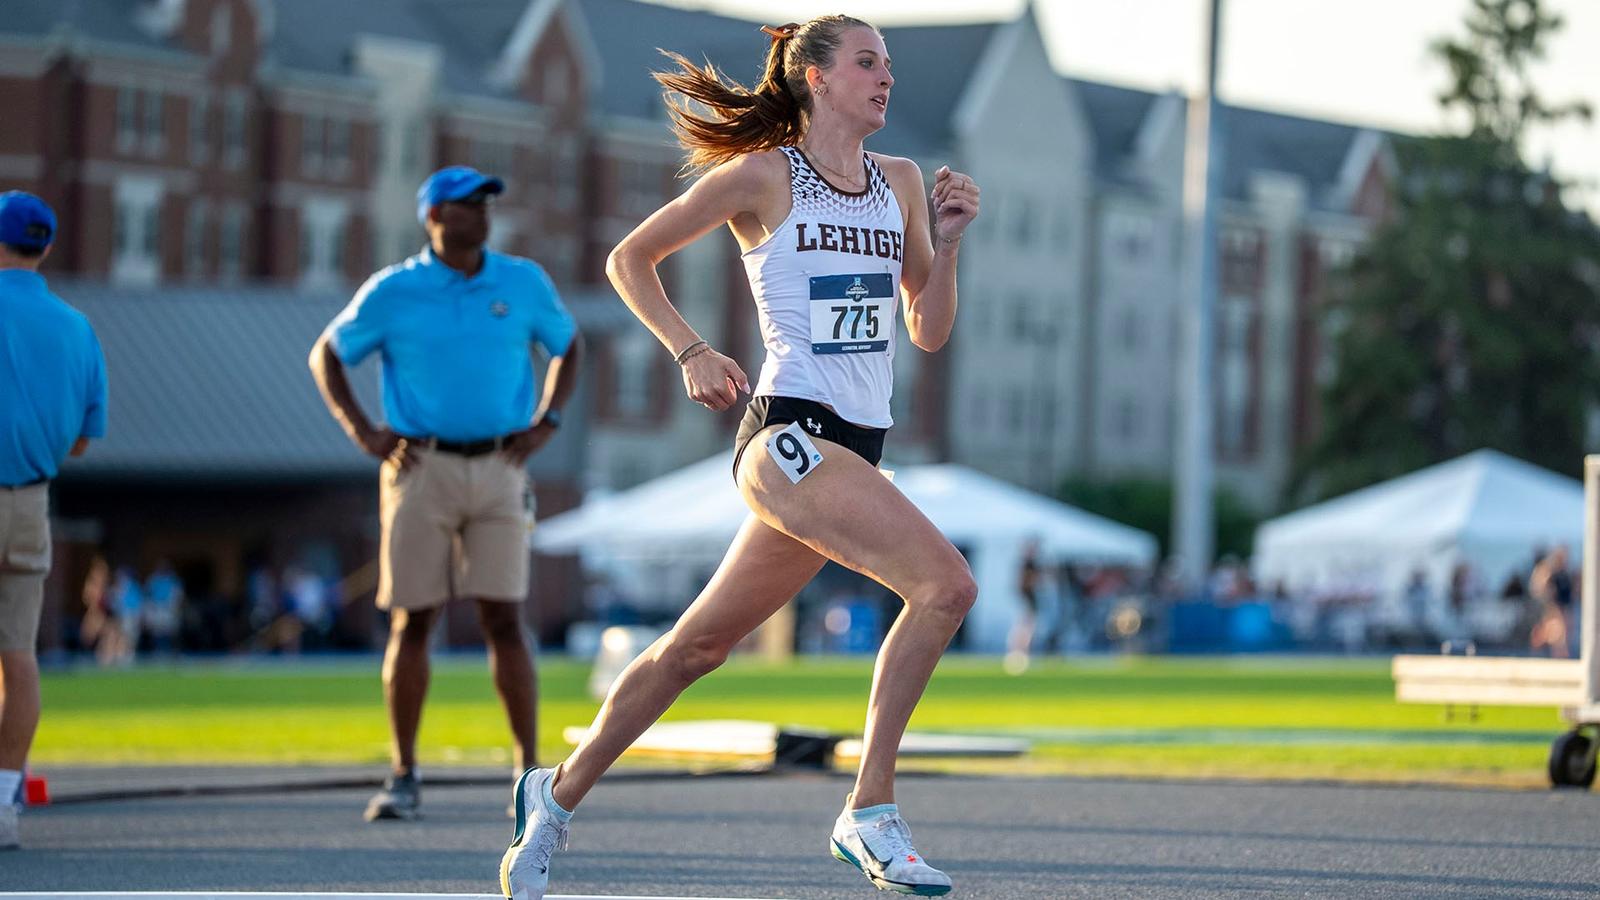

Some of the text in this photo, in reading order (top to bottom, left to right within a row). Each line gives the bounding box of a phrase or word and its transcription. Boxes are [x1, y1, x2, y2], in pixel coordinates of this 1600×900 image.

[796, 223, 902, 263] LEHIGH
[831, 305, 880, 340] 775
[776, 432, 810, 475] 9
